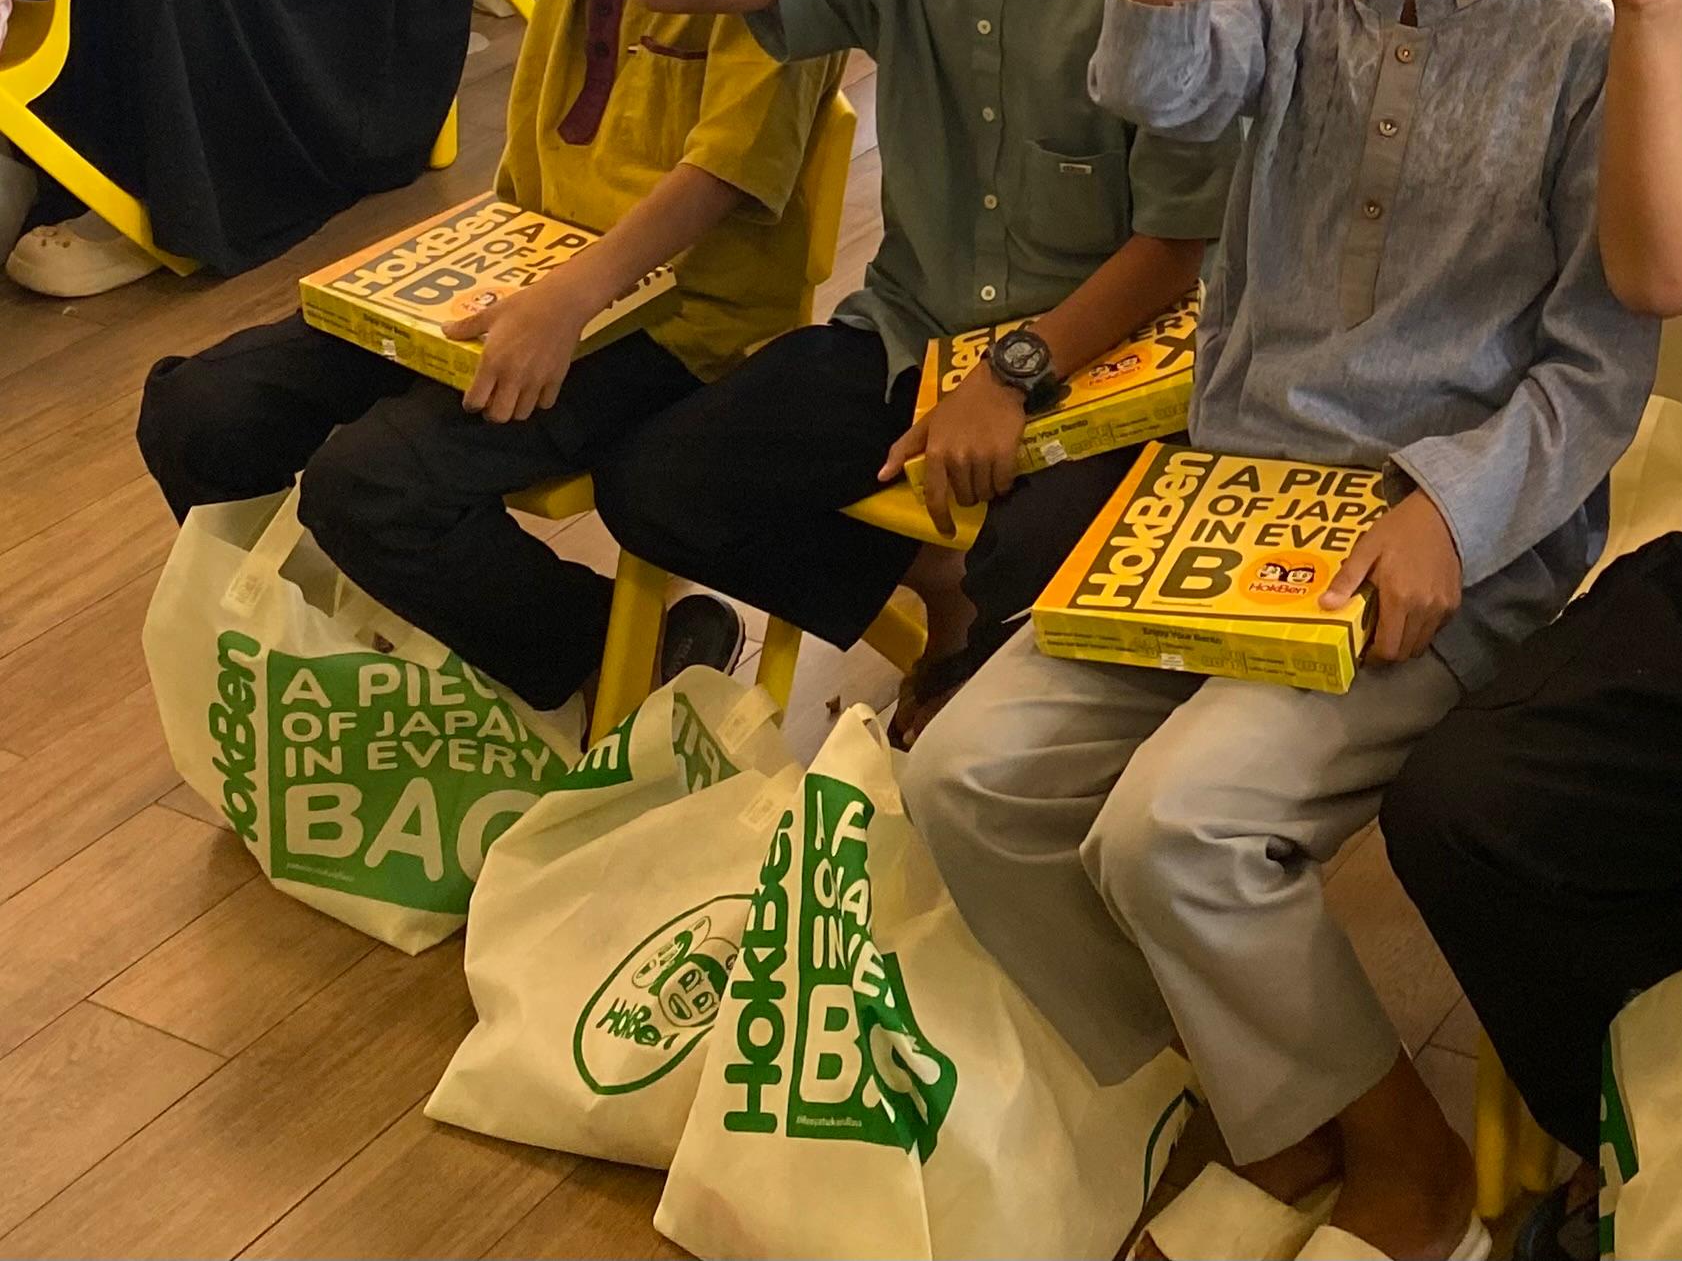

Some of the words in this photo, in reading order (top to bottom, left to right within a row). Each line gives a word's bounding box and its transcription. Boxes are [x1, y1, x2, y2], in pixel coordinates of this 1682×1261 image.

[504, 222, 545, 244] A
[333, 202, 522, 297] HokBen
[451, 251, 496, 275] IN
[483, 240, 536, 263] OF
[1061, 418, 1089, 433] Bento
[1218, 465, 1261, 494] A
[1208, 495, 1275, 520] OF
[1281, 498, 1389, 526] JAPA
[1075, 450, 1214, 608] HokBen
[1191, 519, 1245, 545] IN
[1249, 582, 1309, 597] HokBen
[281, 668, 333, 710] A
[281, 711, 358, 742] OF
[284, 745, 344, 778] IN
[367, 736, 551, 782] EVERY
